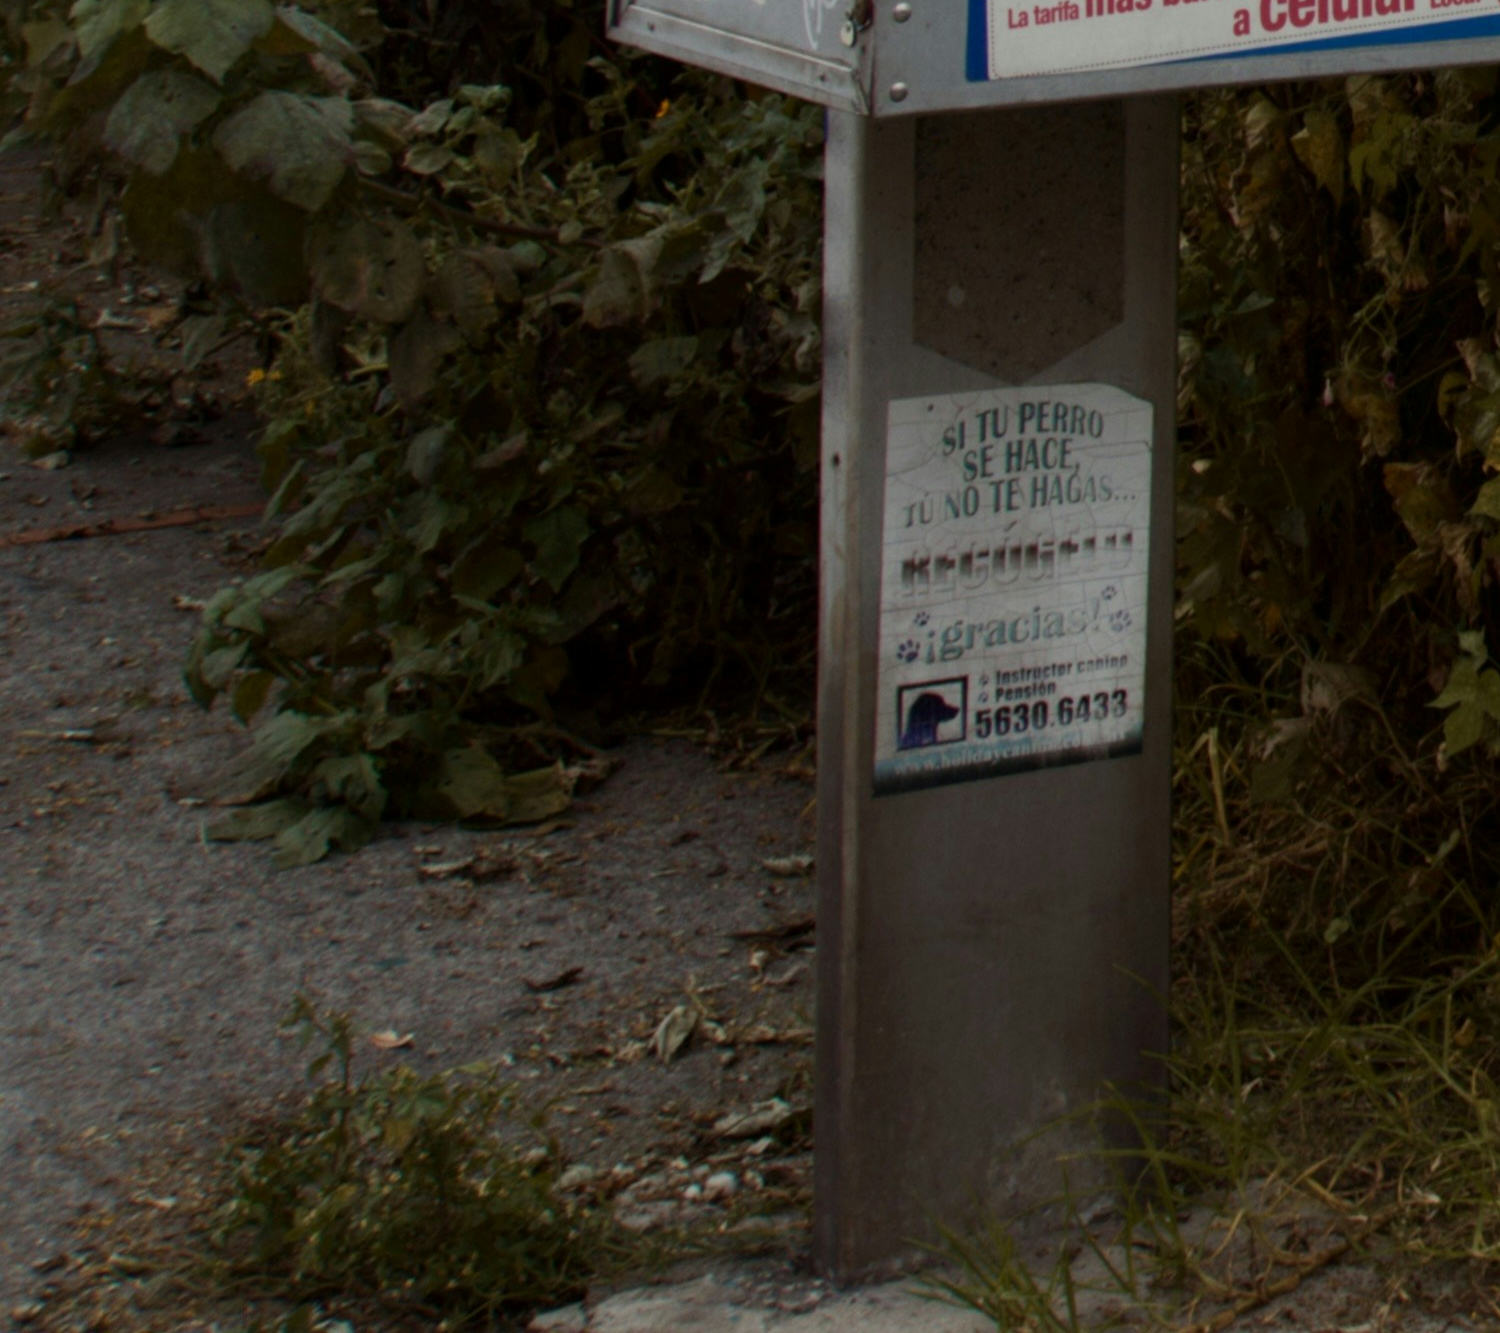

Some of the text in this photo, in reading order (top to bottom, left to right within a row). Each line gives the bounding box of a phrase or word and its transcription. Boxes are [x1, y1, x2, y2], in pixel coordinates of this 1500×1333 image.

[1008, 8, 1028, 29] La
[1034, 0, 1079, 25] tarifa
[1233, 8, 1250, 36] a
[975, 404, 1009, 443] TU
[1019, 400, 1104, 439] PERRO
[963, 437, 1080, 482] SE HACE,
[903, 491, 934, 528] TÚ
[944, 485, 980, 521] NO
[989, 477, 1020, 513] TE
[996, 653, 1129, 684] Instructor canino
[996, 681, 1057, 703] Pensión
[974, 689, 1128, 739] 5630.6433
